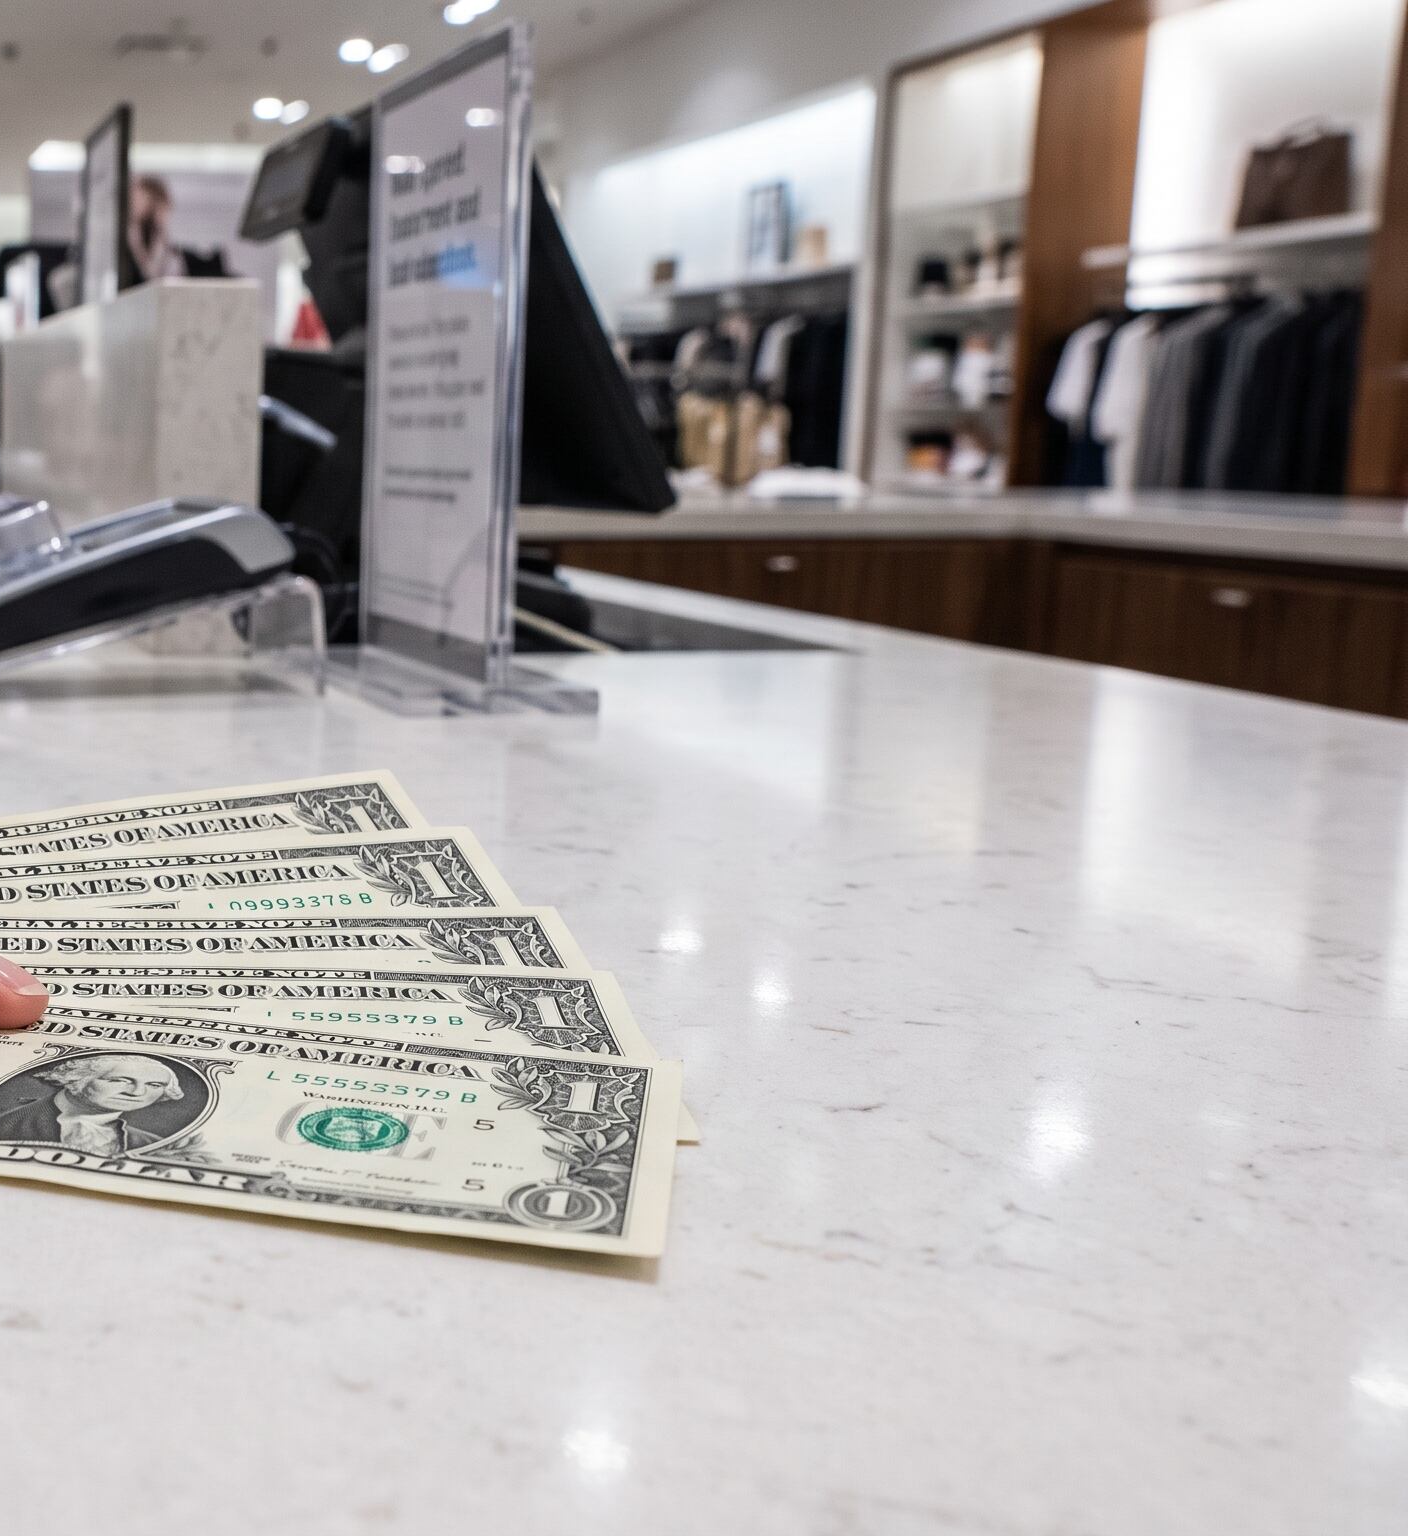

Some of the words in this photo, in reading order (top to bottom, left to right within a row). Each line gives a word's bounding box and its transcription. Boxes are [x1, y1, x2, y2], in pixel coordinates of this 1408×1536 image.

[145, 801, 218, 817] NOTE
[114, 827, 151, 845] OF
[156, 812, 293, 841] AMERICA
[191, 850, 274, 865] NOTE
[26, 876, 147, 899] STATES
[153, 874, 194, 890] OF
[202, 864, 353, 888] AMERICA
[416, 861, 458, 899] 1
[359, 892, 372, 905] B
[242, 919, 332, 929] NOTE
[57, 937, 190, 952] STATES
[196, 937, 243, 952] OF
[249, 935, 416, 950] AMERICA
[73, 983, 209, 997] STATES
[218, 984, 268, 998] OF
[274, 984, 450, 1001] AMERICA
[292, 1011, 437, 1025] 55955379
[448, 1015, 464, 1026] B
[530, 996, 578, 1030] 1
[78, 1025, 223, 1050] STATES
[229, 1040, 284, 1058] OF
[287, 1047, 482, 1081] AMERICA
[266, 1070, 280, 1081] L
[460, 1092, 477, 1104] B
[559, 1082, 604, 1115] 1
[473, 1119, 495, 1131] 5
[461, 1178, 485, 1191] 5
[544, 1190, 571, 1218] 1
